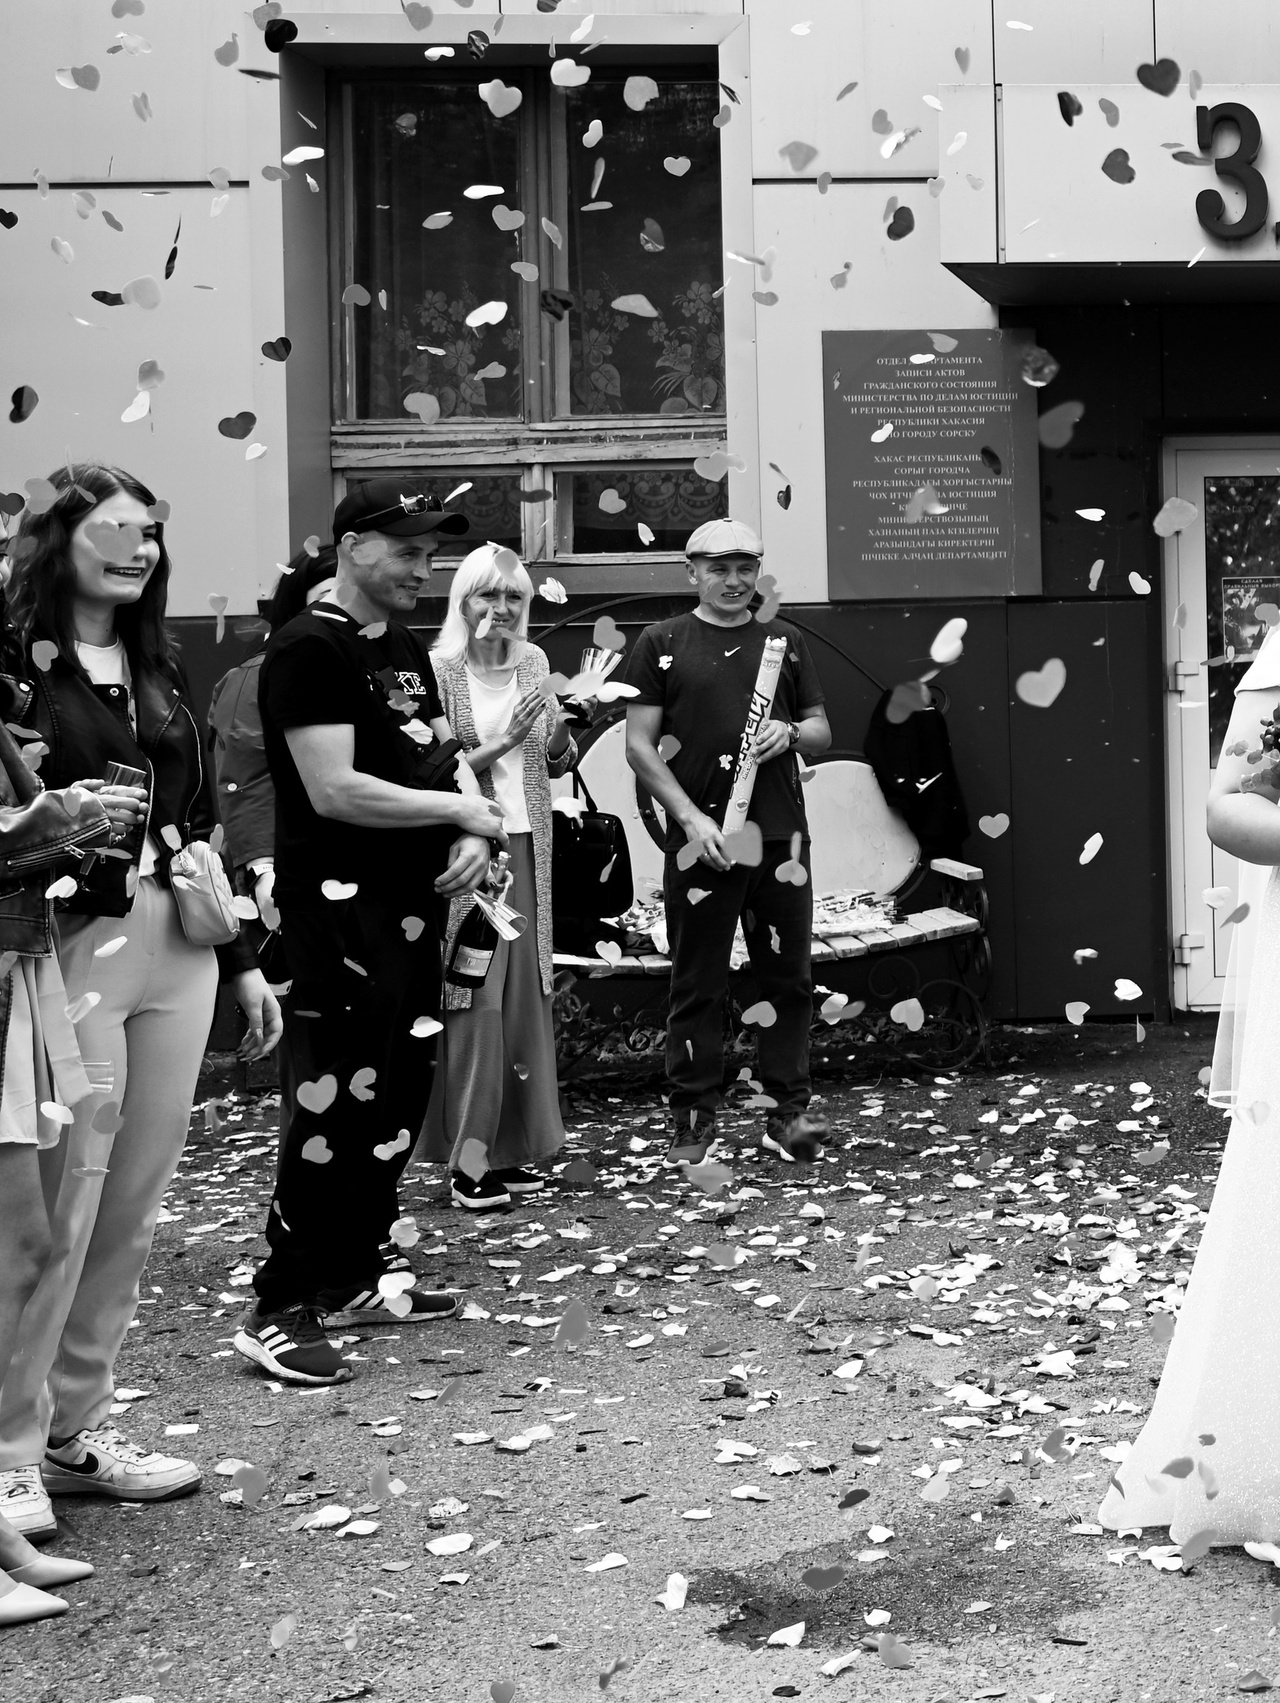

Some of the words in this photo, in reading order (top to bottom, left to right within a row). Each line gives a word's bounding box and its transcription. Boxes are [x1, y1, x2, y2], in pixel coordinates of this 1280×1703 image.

[876, 357, 907, 366] ОТДЕЛ
[895, 369, 932, 378] ЗАПИСИ
[934, 369, 966, 377] АКТОВ
[863, 381, 939, 391] ГРАЖДАНСКОГО
[940, 380, 997, 389] СОСТОЯНИЯ
[842, 394, 918, 402] МИНИСТЕРСТВА
[935, 393, 968, 402] ДЕЛАМ
[970, 392, 1018, 401] ЮСТИЦИИ
[850, 406, 858, 414] И
[860, 405, 935, 414] РЕГИОНАЛЬНОЙ
[937, 404, 1011, 413] БЕЗОПАСНОСТИ
[942, 417, 986, 425] ХАКАСИЯ
[902, 430, 938, 439] ГОРОДУ
[939, 429, 977, 438] СОРСКУ
[874, 455, 905, 463] ХАКАС
[928, 466, 971, 475] ГОРОДЧА
[869, 492, 887, 500] ЧОХ
[949, 490, 997, 498] ЮСТИЦИЯ
